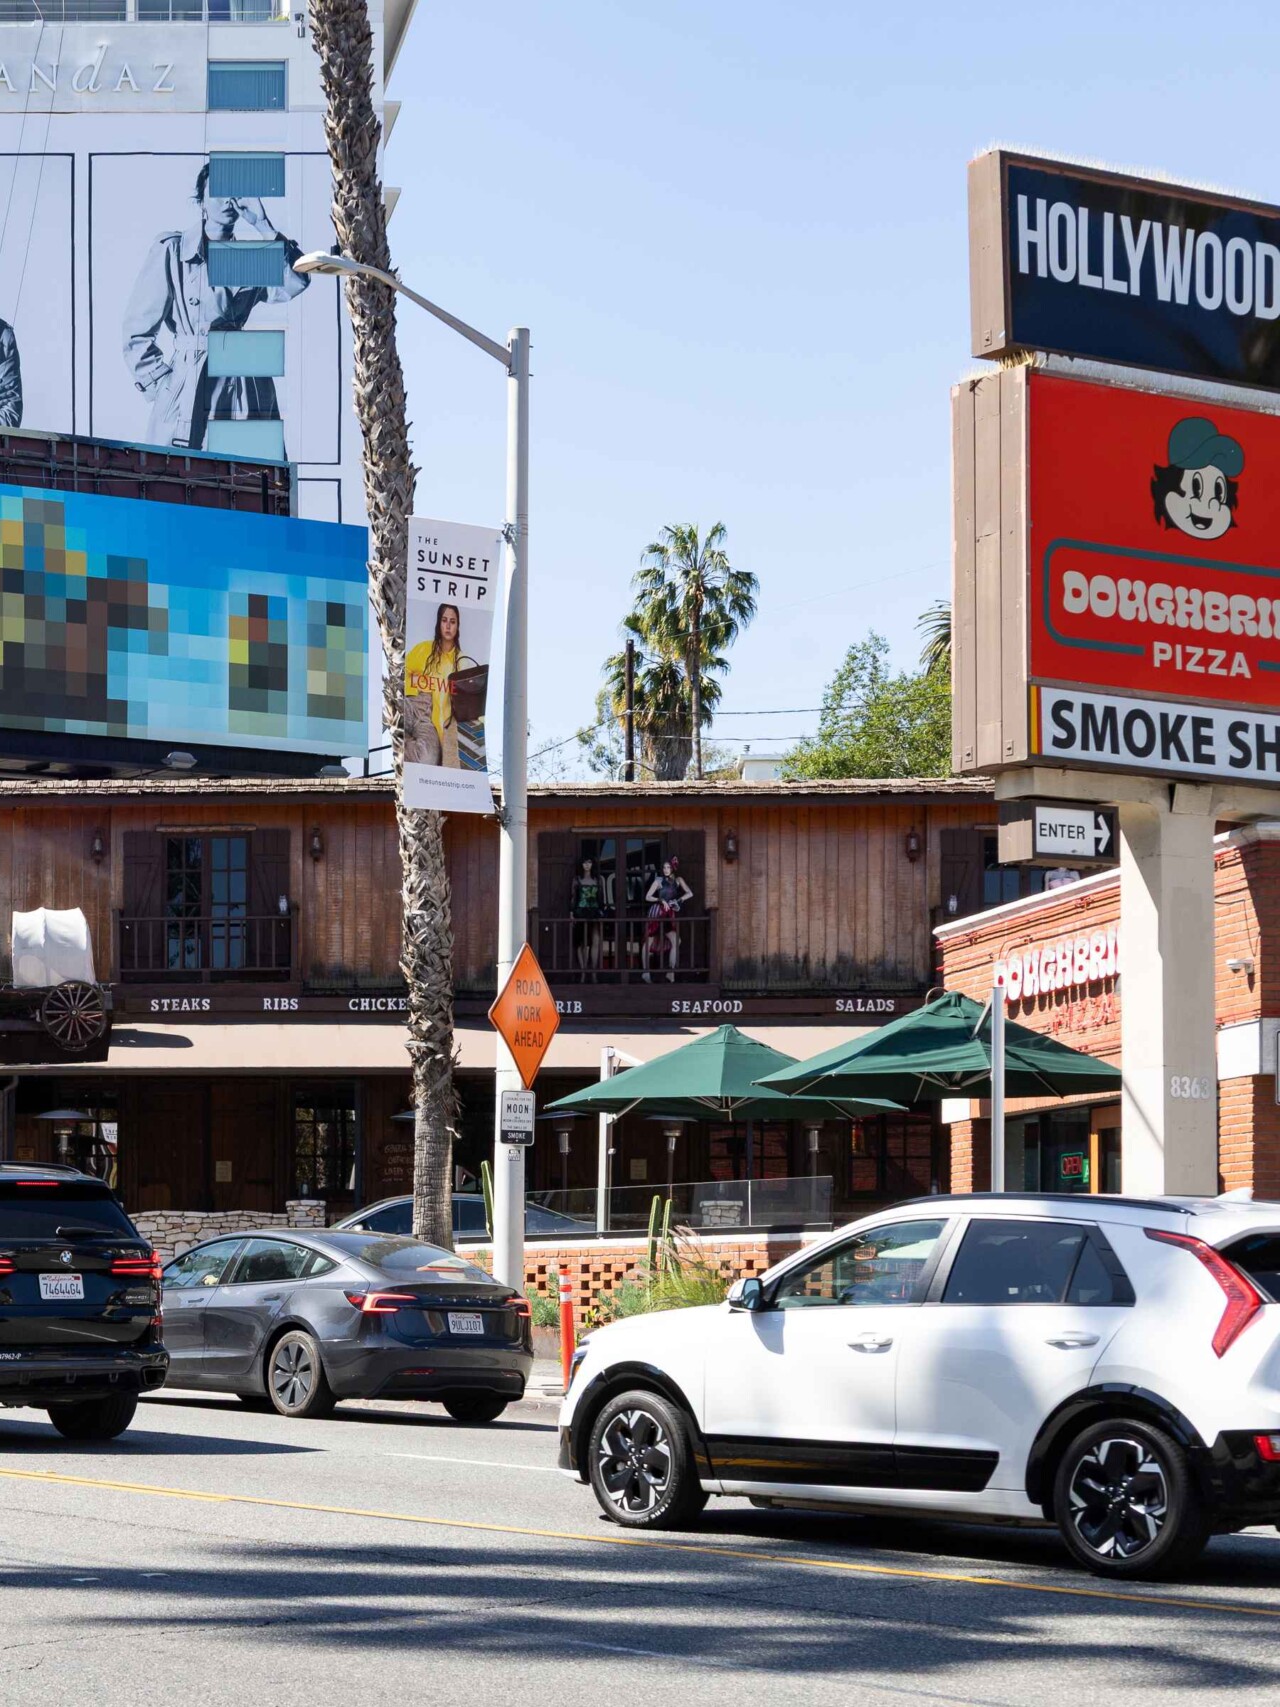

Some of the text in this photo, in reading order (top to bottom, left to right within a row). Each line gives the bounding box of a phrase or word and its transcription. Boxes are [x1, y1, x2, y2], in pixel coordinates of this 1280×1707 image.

[1018, 194, 1280, 320] HOLLYWOOD
[418, 536, 438, 546] THE
[417, 549, 490, 572] SUNSET
[417, 577, 487, 600] STRIP
[1062, 570, 1280, 640] DOUGHBRI
[1153, 641, 1252, 679] PIZZA
[410, 672, 458, 696] LOEWE
[1051, 699, 1216, 765] SMOKE
[419, 777, 476, 789] thesunsetstrip.com
[1038, 822, 1086, 840] ENTER
[993, 926, 1121, 1001] DOUGHBRI
[516, 979, 542, 996] ROAD
[150, 998, 211, 1011] STEAKS
[263, 998, 299, 1011] RIBS
[348, 998, 409, 1011] CHICKE
[556, 1000, 582, 1013] RIB
[671, 1000, 743, 1013] SEAFOOD
[835, 998, 895, 1012] SALADS
[516, 1006, 542, 1023] WORK
[514, 1030, 544, 1048] AHEAD
[1170, 1075, 1211, 1099] 8363
[506, 1104, 529, 1114] MOON
[507, 1132, 526, 1140] SMOKE
[1063, 1156, 1082, 1175] OPEN
[43, 1283, 81, 1295] 74644G4
[451, 1320, 481, 1331] 9ULJ107
